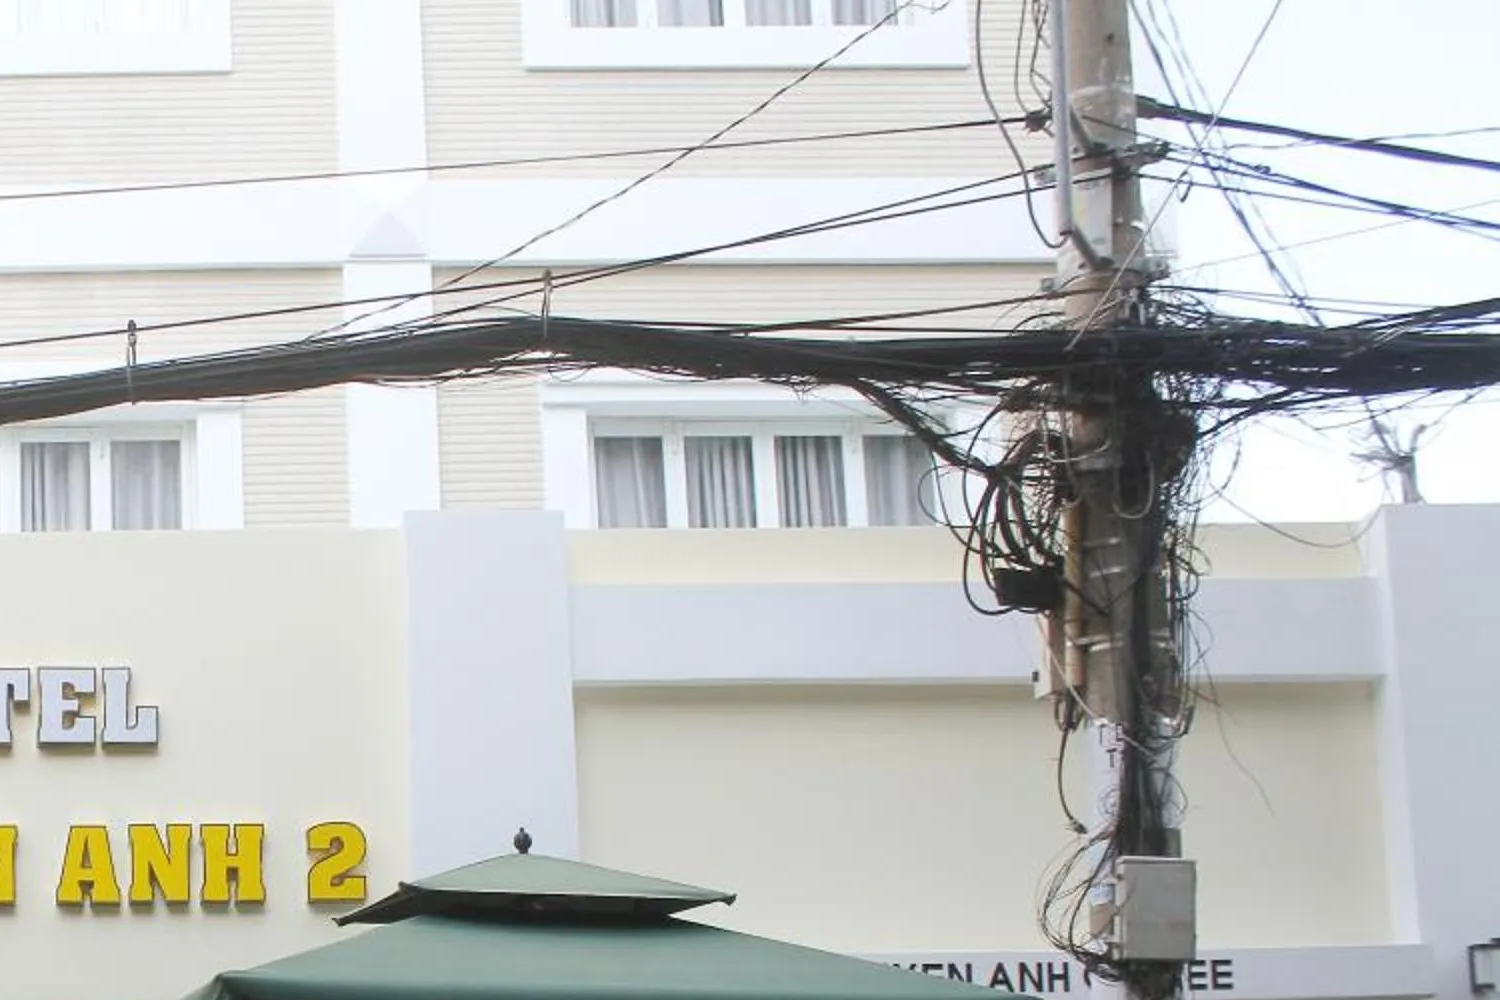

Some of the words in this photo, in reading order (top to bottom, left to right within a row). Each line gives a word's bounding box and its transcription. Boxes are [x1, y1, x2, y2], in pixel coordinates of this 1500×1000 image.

[56, 823, 267, 908] ANH
[306, 821, 368, 906] 2
[988, 960, 1070, 993] ANH
